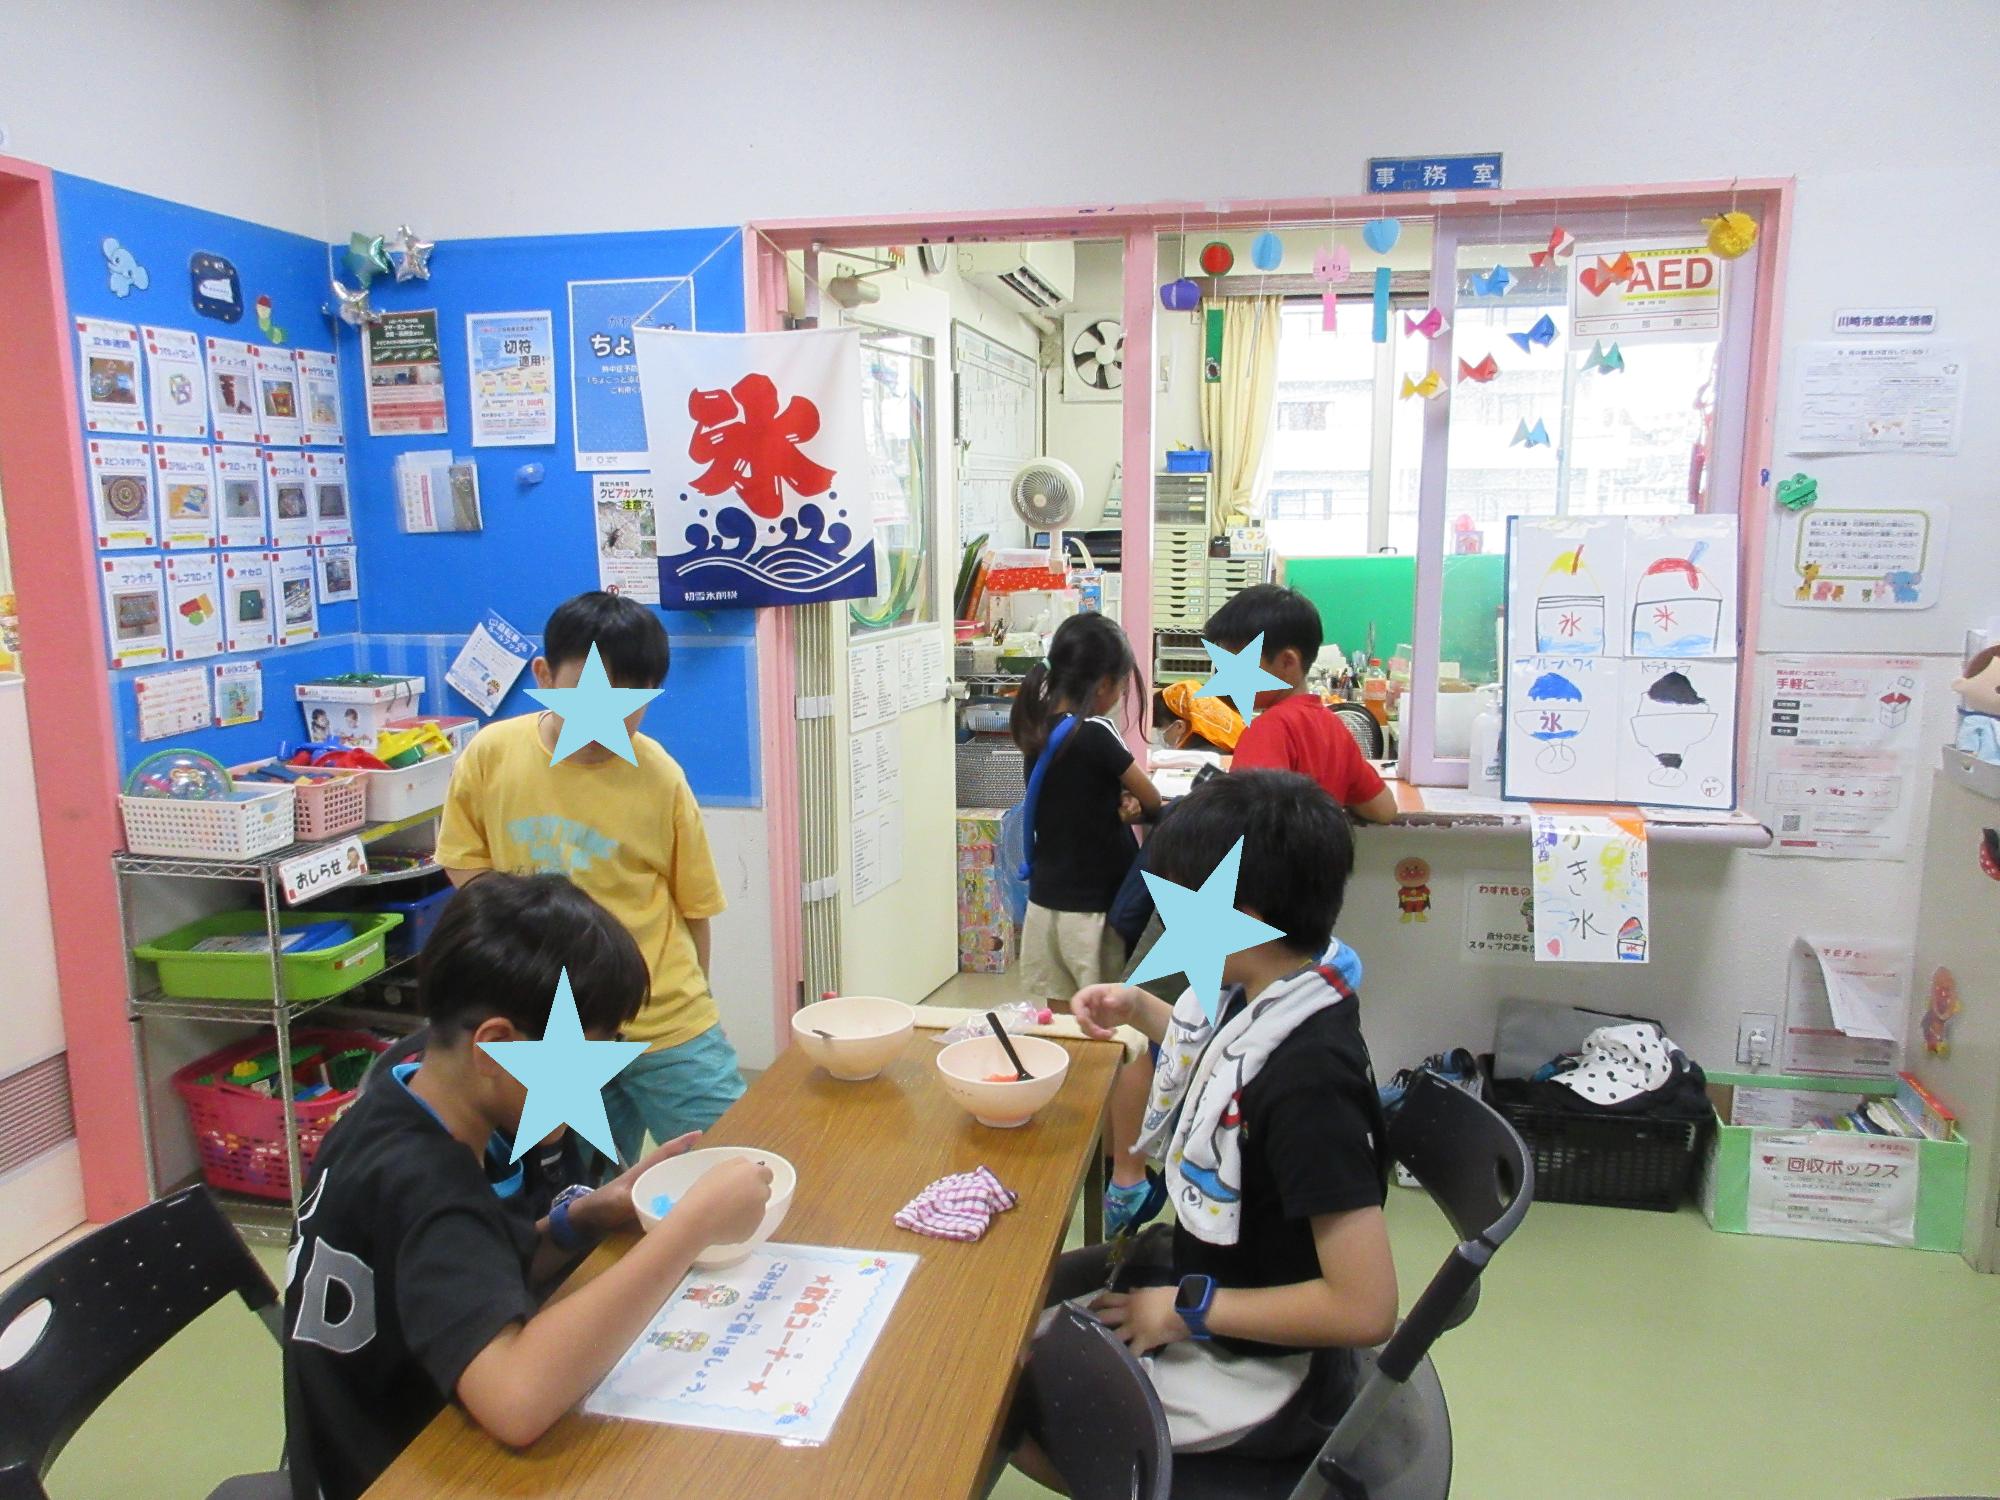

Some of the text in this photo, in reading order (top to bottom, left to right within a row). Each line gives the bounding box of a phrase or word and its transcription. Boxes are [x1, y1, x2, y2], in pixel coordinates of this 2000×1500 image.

[1375, 163, 1494, 188] 事務室
[1626, 257, 1713, 293] AED
[1838, 314, 1933, 327] 川崎市感染症情報
[504, 339, 531, 355] 切符
[688, 373, 838, 519] 氷
[1558, 611, 1582, 637] 氷
[1515, 656, 1594, 671] ブルーハワイ
[1776, 677, 1816, 690] 手軽に
[1540, 711, 1563, 732] 氷
[296, 860, 342, 890] おしらせ
[1479, 885, 1531, 897] わすれもの
[1787, 1156, 1900, 1179] 回収ボックス
